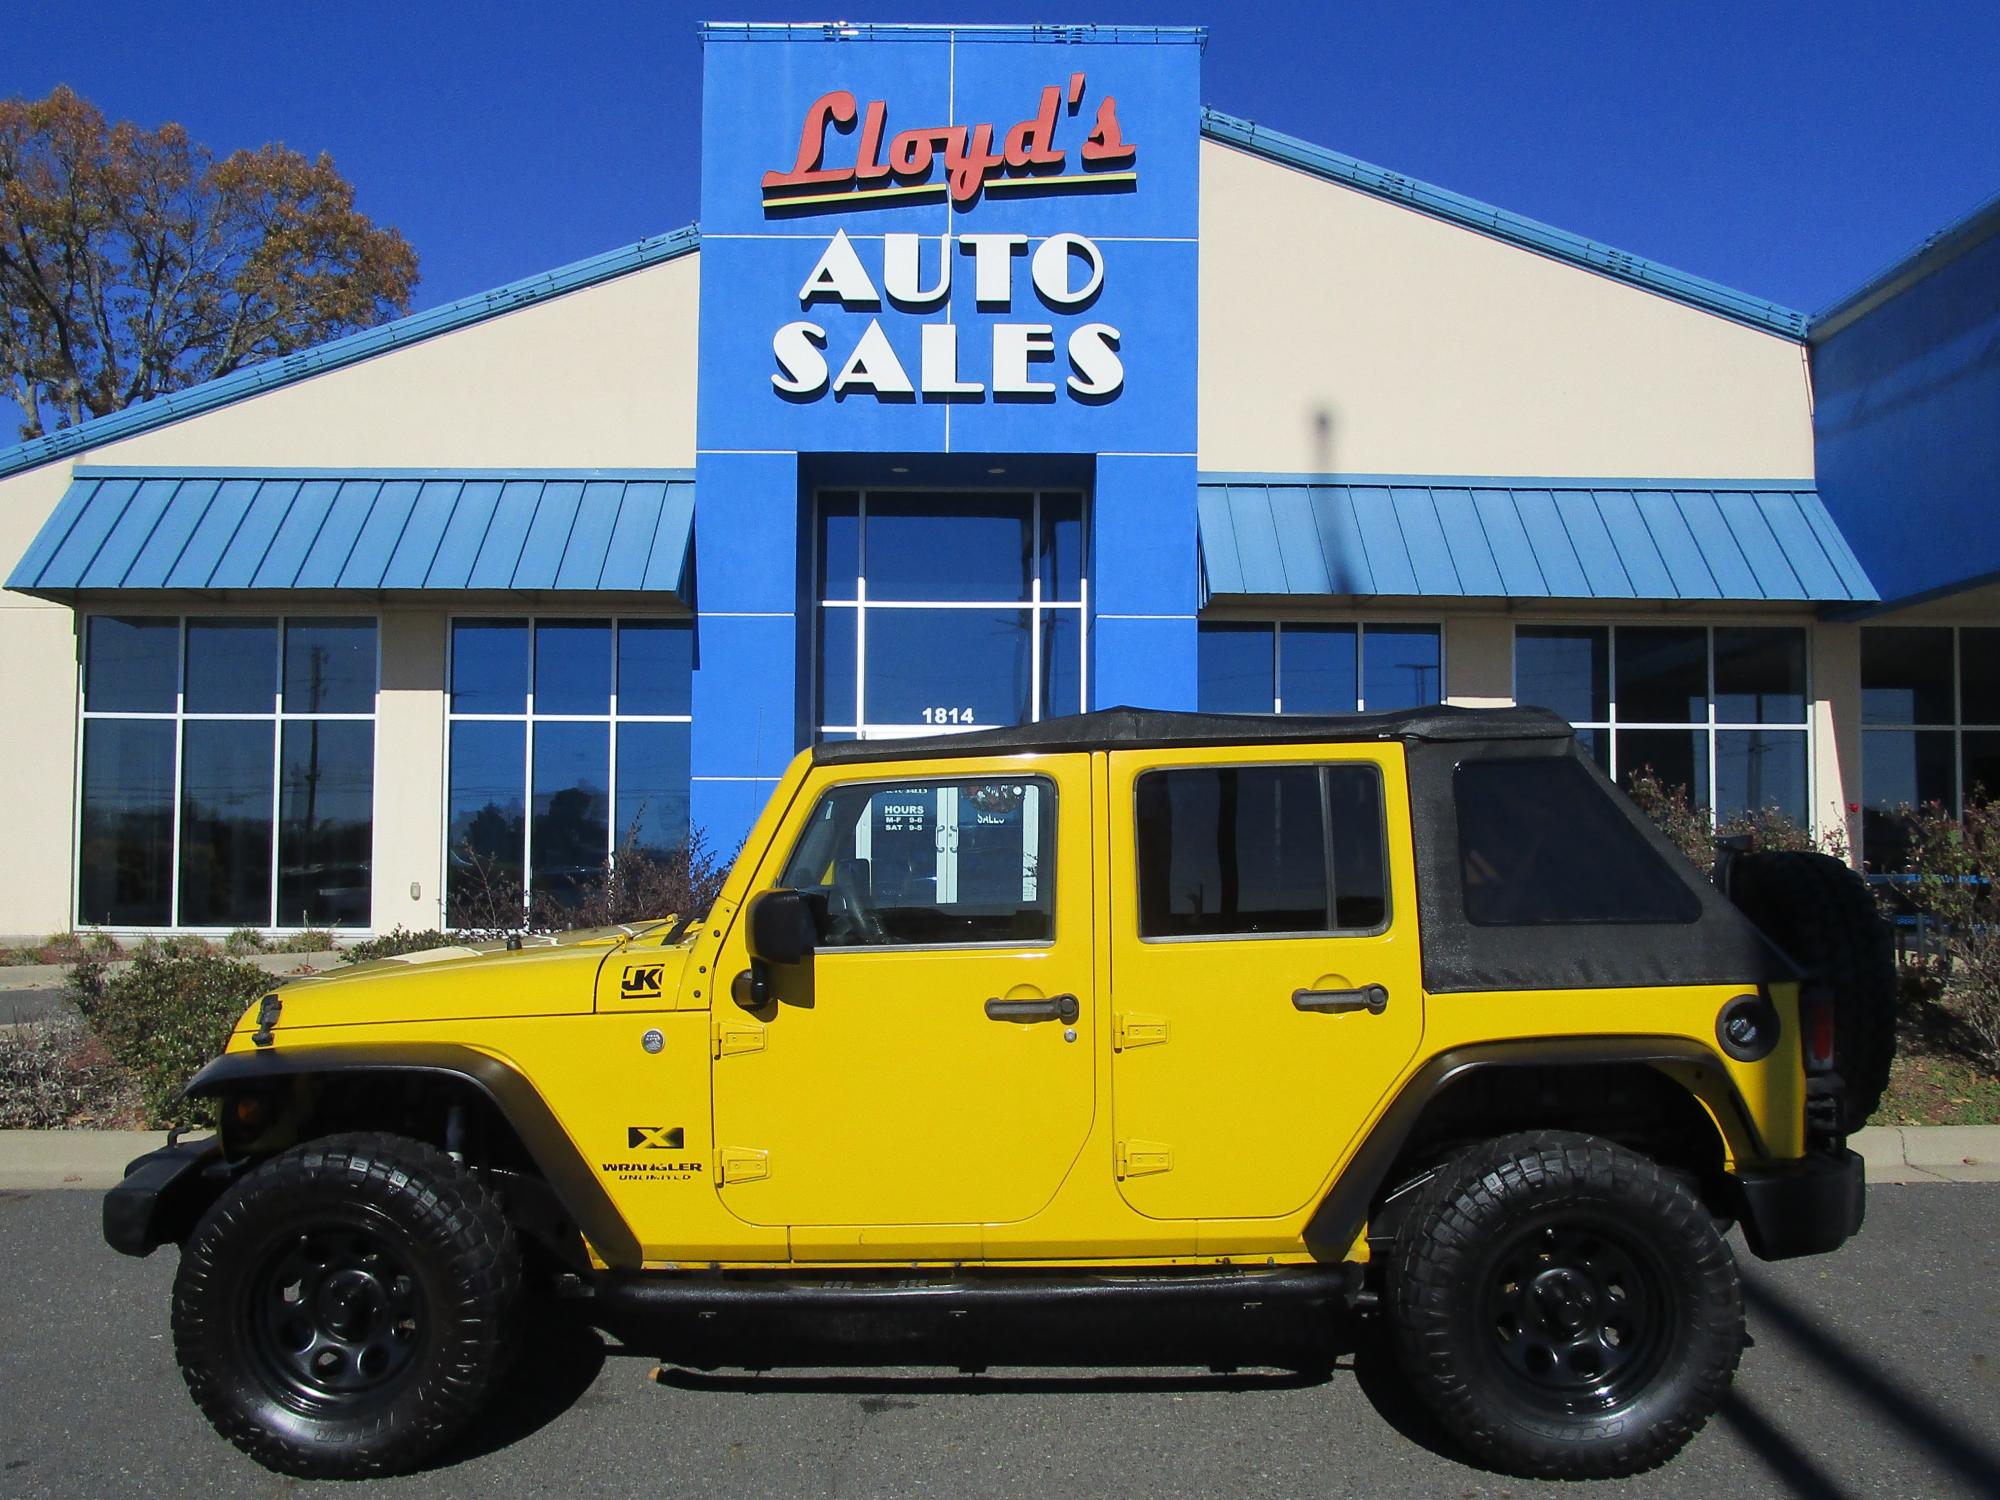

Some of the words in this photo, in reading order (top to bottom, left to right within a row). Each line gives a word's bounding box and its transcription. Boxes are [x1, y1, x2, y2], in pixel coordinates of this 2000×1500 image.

[761, 72, 1136, 201] Lloyd's
[799, 227, 1104, 303] AUTO
[771, 318, 1123, 395] SALES
[922, 707, 975, 724] 1814
[884, 805, 924, 814] HOURS
[621, 968, 661, 991] JK
[602, 1163, 702, 1172] WRANGLER
